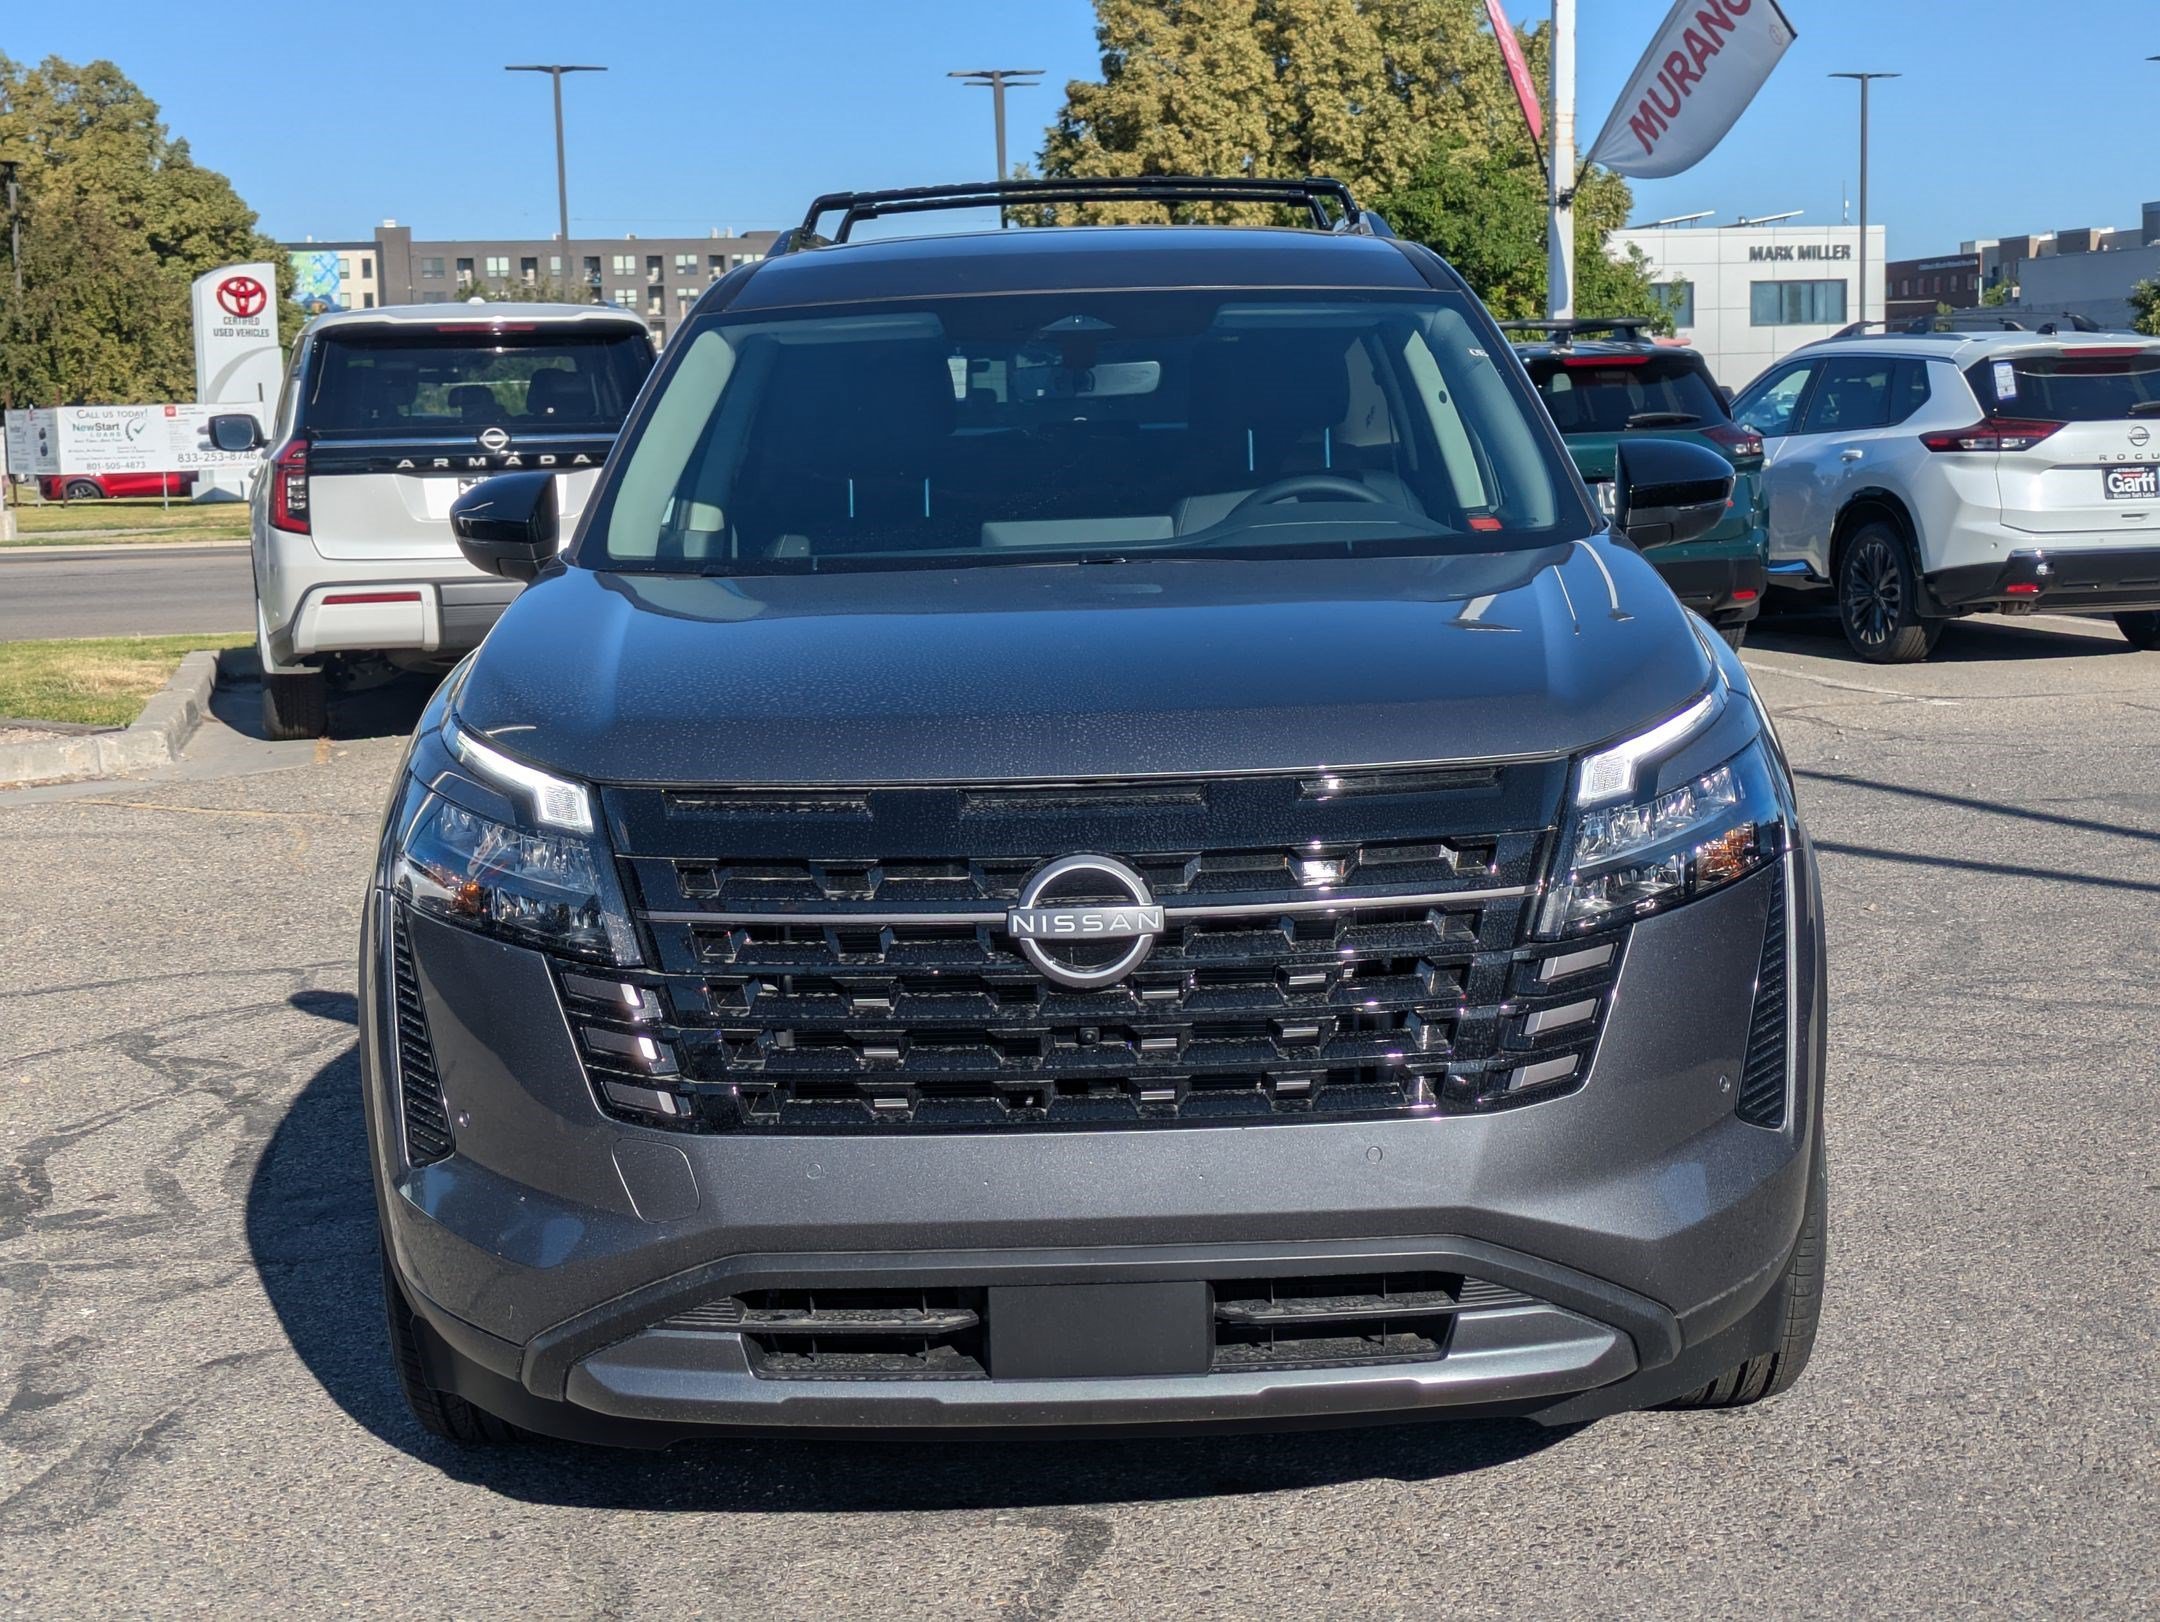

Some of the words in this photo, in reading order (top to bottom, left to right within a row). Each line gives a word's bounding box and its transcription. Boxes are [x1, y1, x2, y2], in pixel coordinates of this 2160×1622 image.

[1749, 246, 1794, 262] MARK
[1797, 245, 1851, 261] MILLER
[223, 316, 260, 326] CERTIFIED
[213, 328, 234, 337] USED
[236, 328, 270, 337] VEHICLES
[72, 422, 120, 432] NewStart
[396, 453, 592, 469] ARMADA
[2107, 471, 2156, 493] Garff
[1012, 911, 1160, 933] NISSAN
